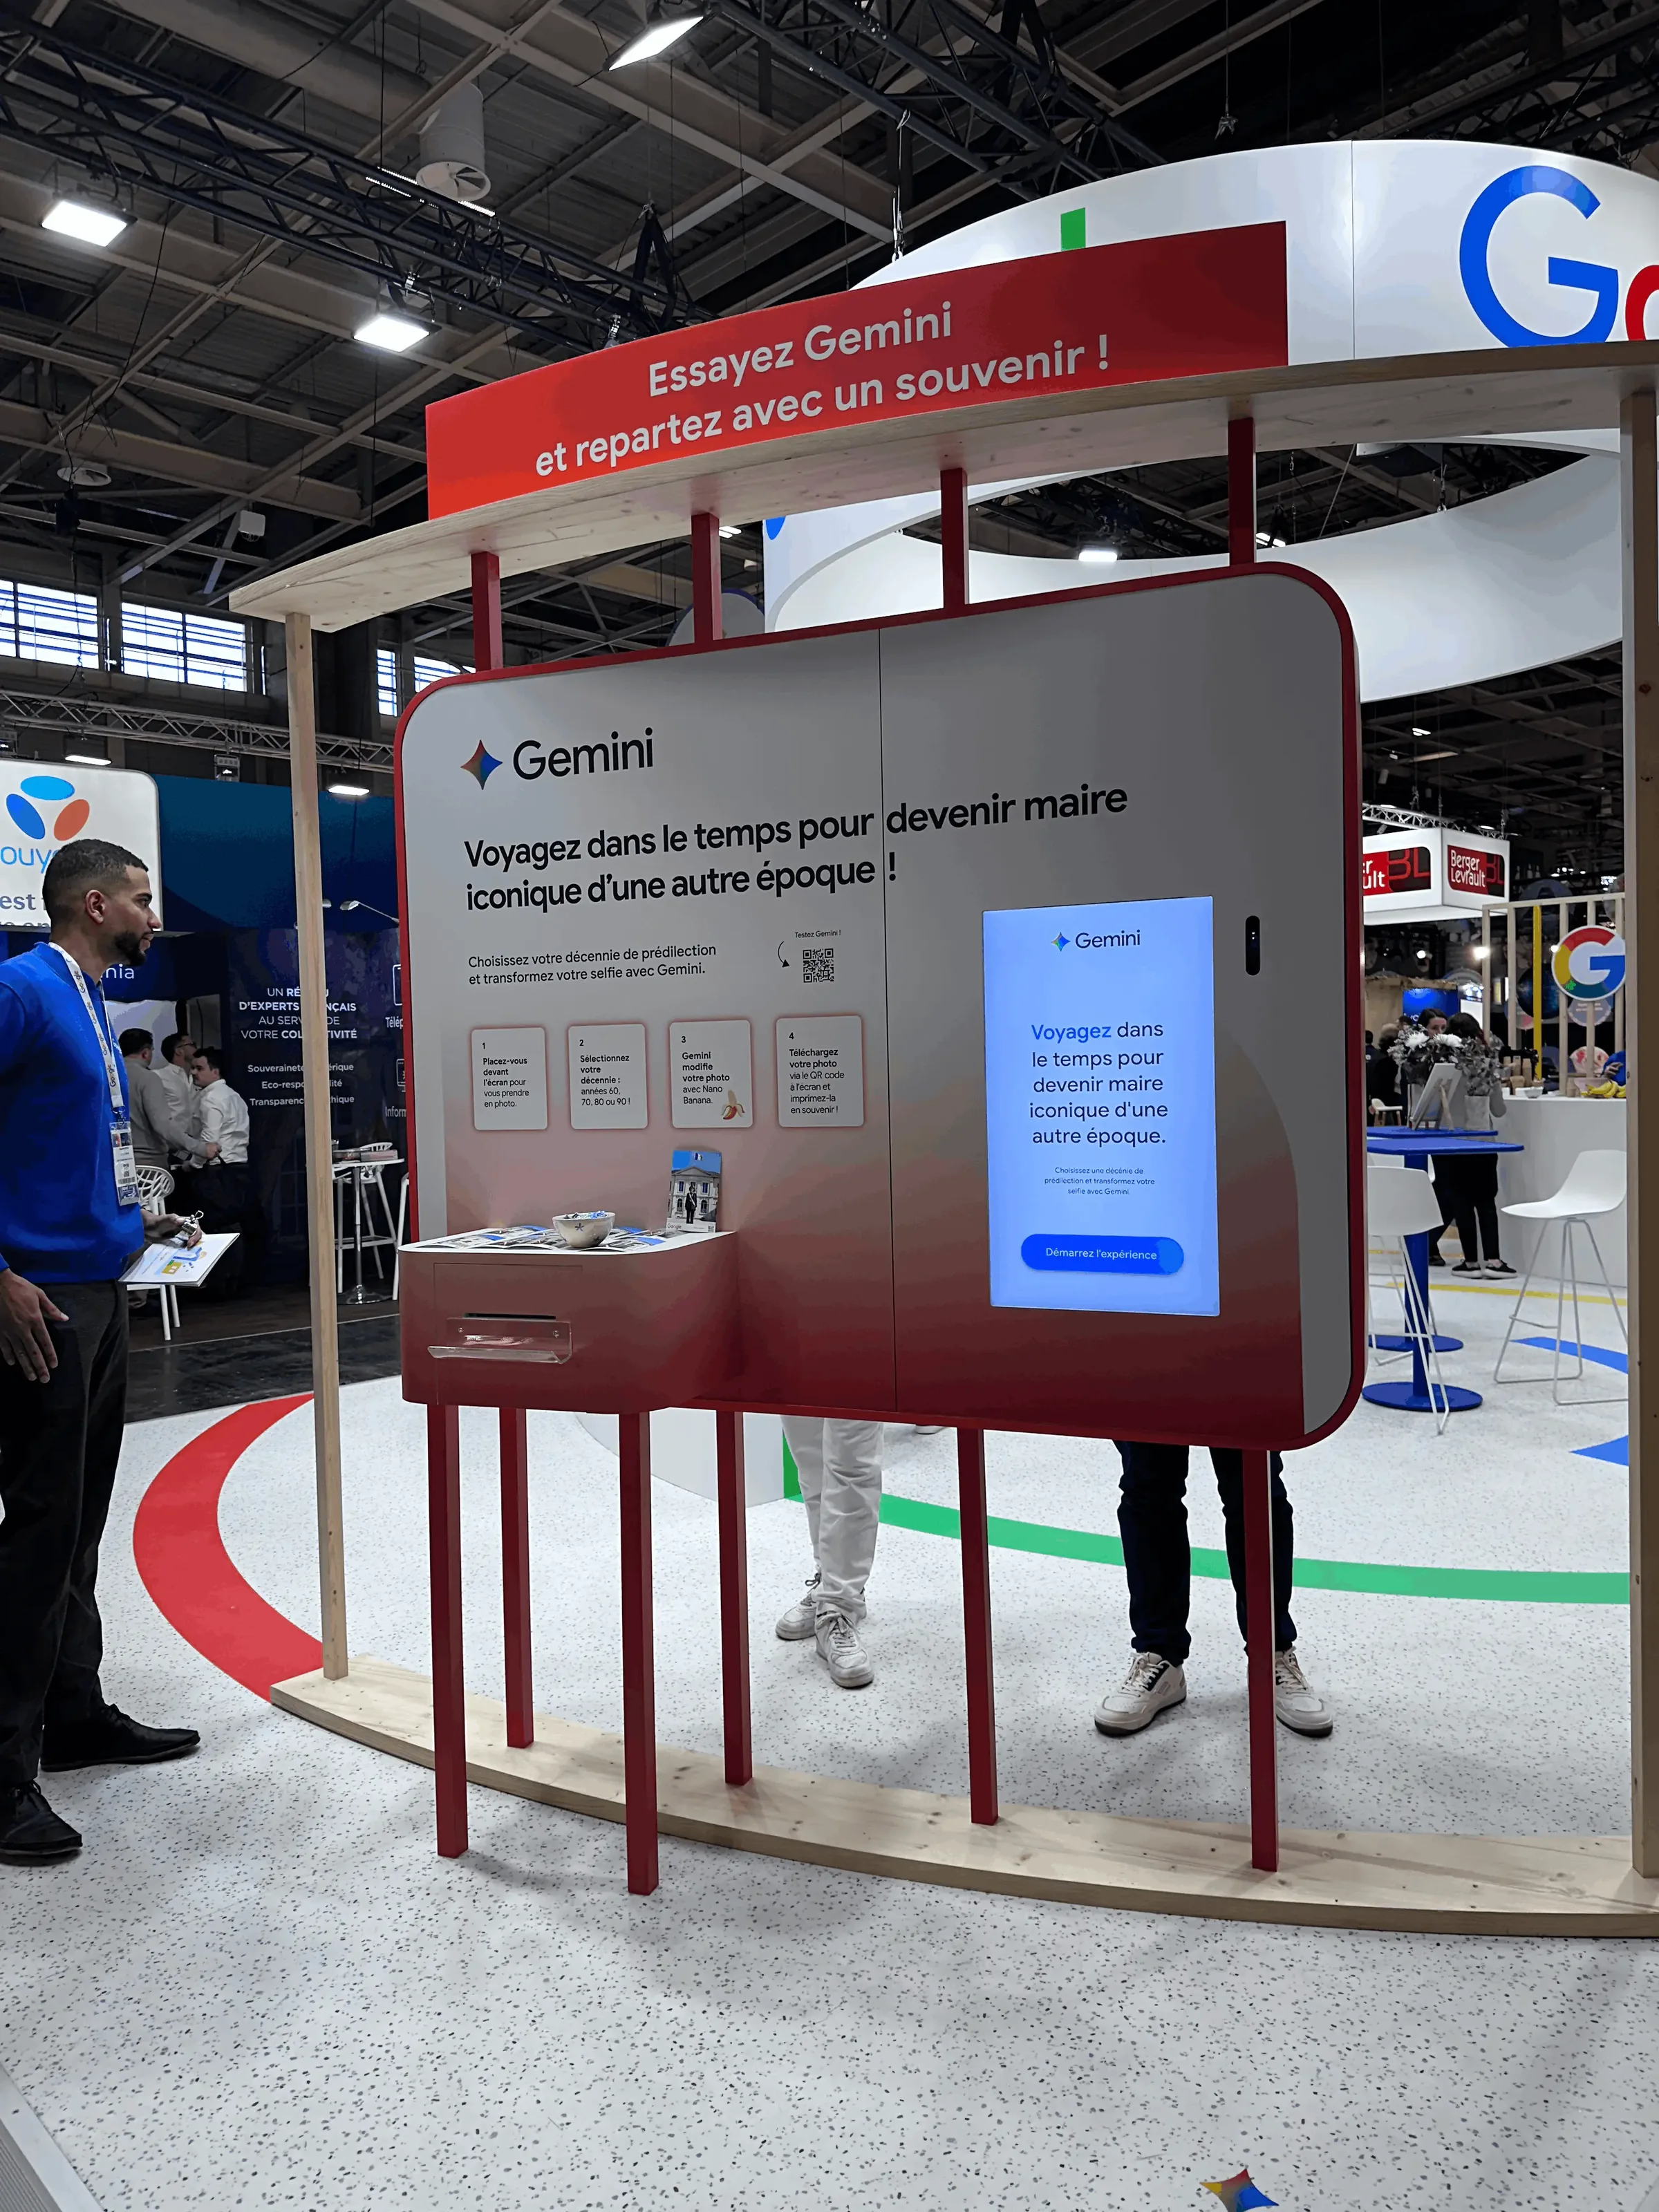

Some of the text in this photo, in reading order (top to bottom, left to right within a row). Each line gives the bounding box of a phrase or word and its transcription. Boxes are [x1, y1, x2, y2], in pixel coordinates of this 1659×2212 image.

[649, 301, 952, 397] Essayez Gemini
[536, 334, 1109, 476] et repartez avec un souvenir !
[513, 727, 654, 780] Gemini
[465, 782, 1127, 872] Voyagez dans le temps pour devenir maire
[1, 845, 58, 874] ouy
[1451, 850, 1480, 872] Berger
[467, 879, 581, 912] iconique
[672, 867, 750, 897] autre
[756, 860, 875, 897] époque
[888, 852, 897, 881] !
[1451, 868, 1485, 888] Levrault
[0, 894, 36, 910] est
[1075, 929, 1141, 949] Gemini
[469, 944, 716, 968] Choisissez votre décennie de prédilection
[101, 964, 134, 979] nia
[469, 962, 706, 984] et transformez votre selfie avec Gemini.
[241, 1030, 278, 1038] VOTRE
[1031, 1022, 1163, 1044] Voyagez dans
[580, 1054, 630, 1062] Sélectionnez
[682, 1051, 711, 1060] Gemini
[789, 1048, 838, 1058] Téléchargez
[482, 1057, 527, 1065] Placez-vous
[682, 1062, 713, 1071] modifie
[812, 1060, 837, 1069] photo
[1032, 1051, 1163, 1070] le temps pour
[581, 1076, 616, 1085] décennie
[706, 1073, 730, 1083] photo
[824, 1071, 845, 1079] code
[702, 1085, 723, 1093] Nano
[789, 1082, 795, 1091] à
[1033, 1075, 1163, 1093] devenir maire
[502, 1089, 529, 1098] prendre
[581, 1087, 607, 1095] années
[494, 1100, 517, 1109] photo.
[594, 1098, 604, 1106] 80
[790, 1094, 836, 1103] imprimez-la
[802, 1105, 834, 1114] souvenir
[1029, 1101, 1168, 1121] iconique d'une
[1032, 1127, 1166, 1147] autre époque.
[1046, 1247, 1157, 1260] Démarrez l'expérience
